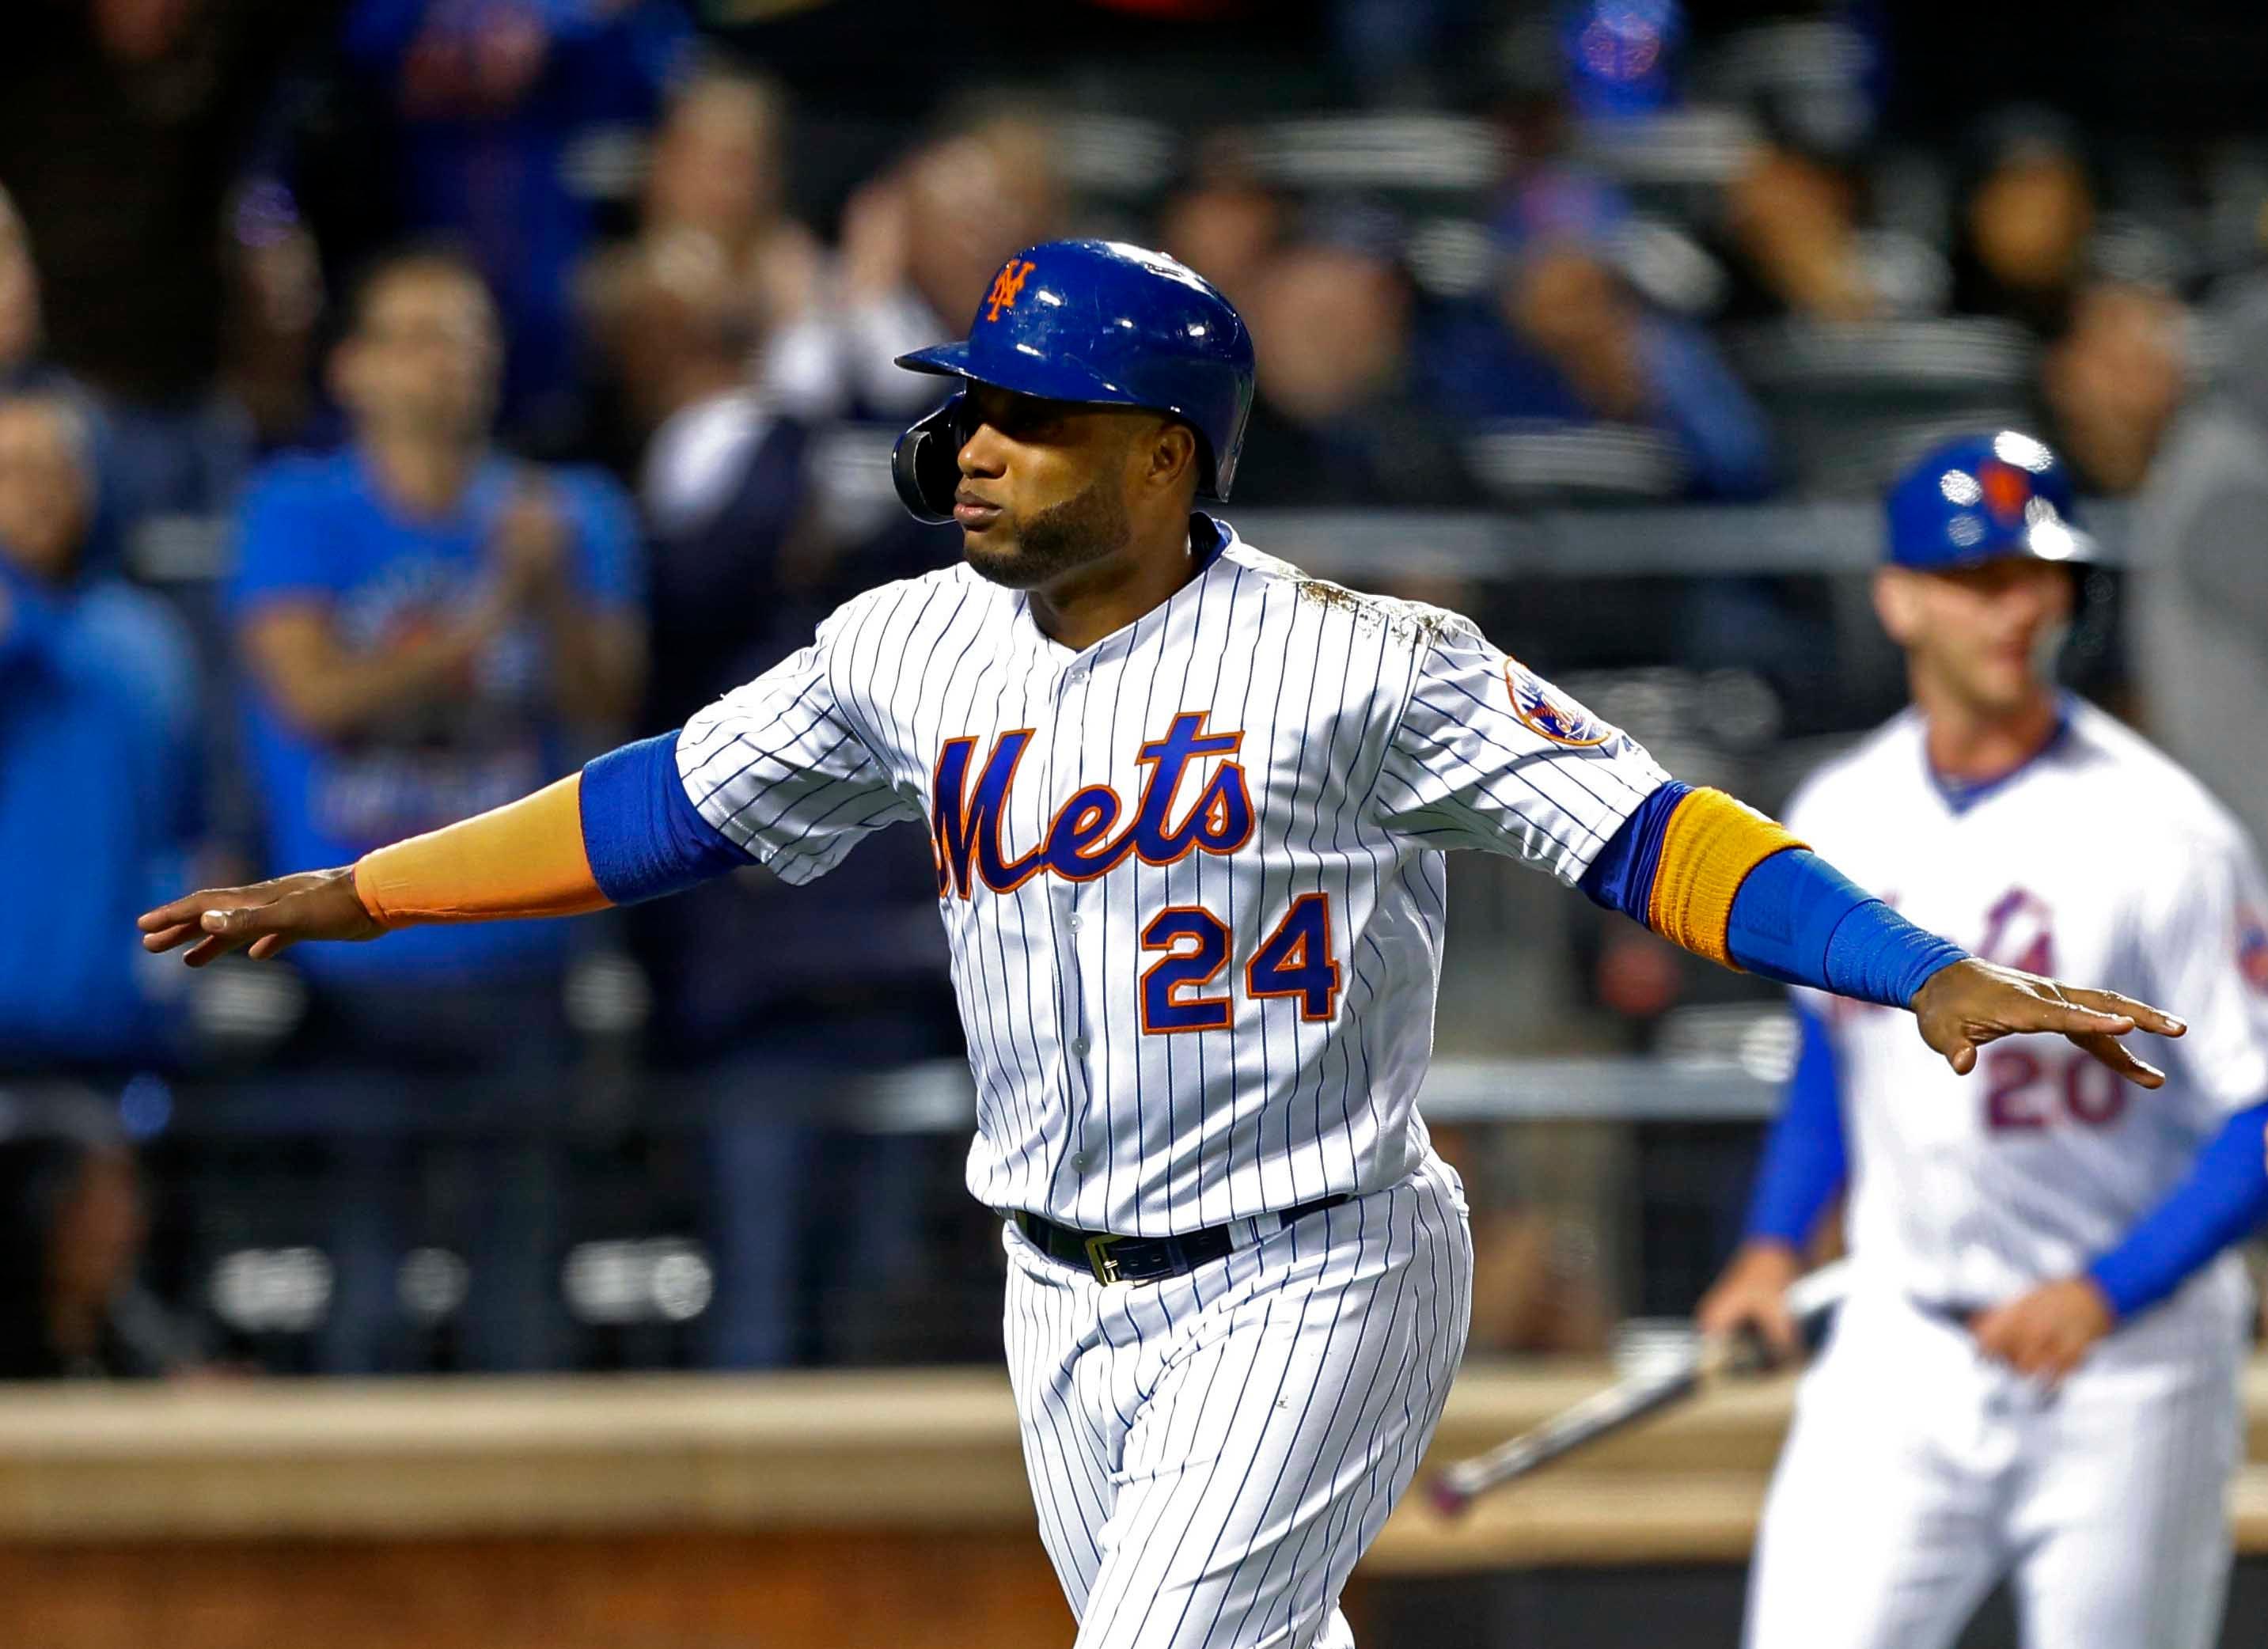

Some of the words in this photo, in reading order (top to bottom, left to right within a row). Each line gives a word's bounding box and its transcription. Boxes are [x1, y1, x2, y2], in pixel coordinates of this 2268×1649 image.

[931, 711, 1255, 900] Mets
[1141, 893, 1340, 1035] 24
[1984, 1046, 2127, 1132] 20
